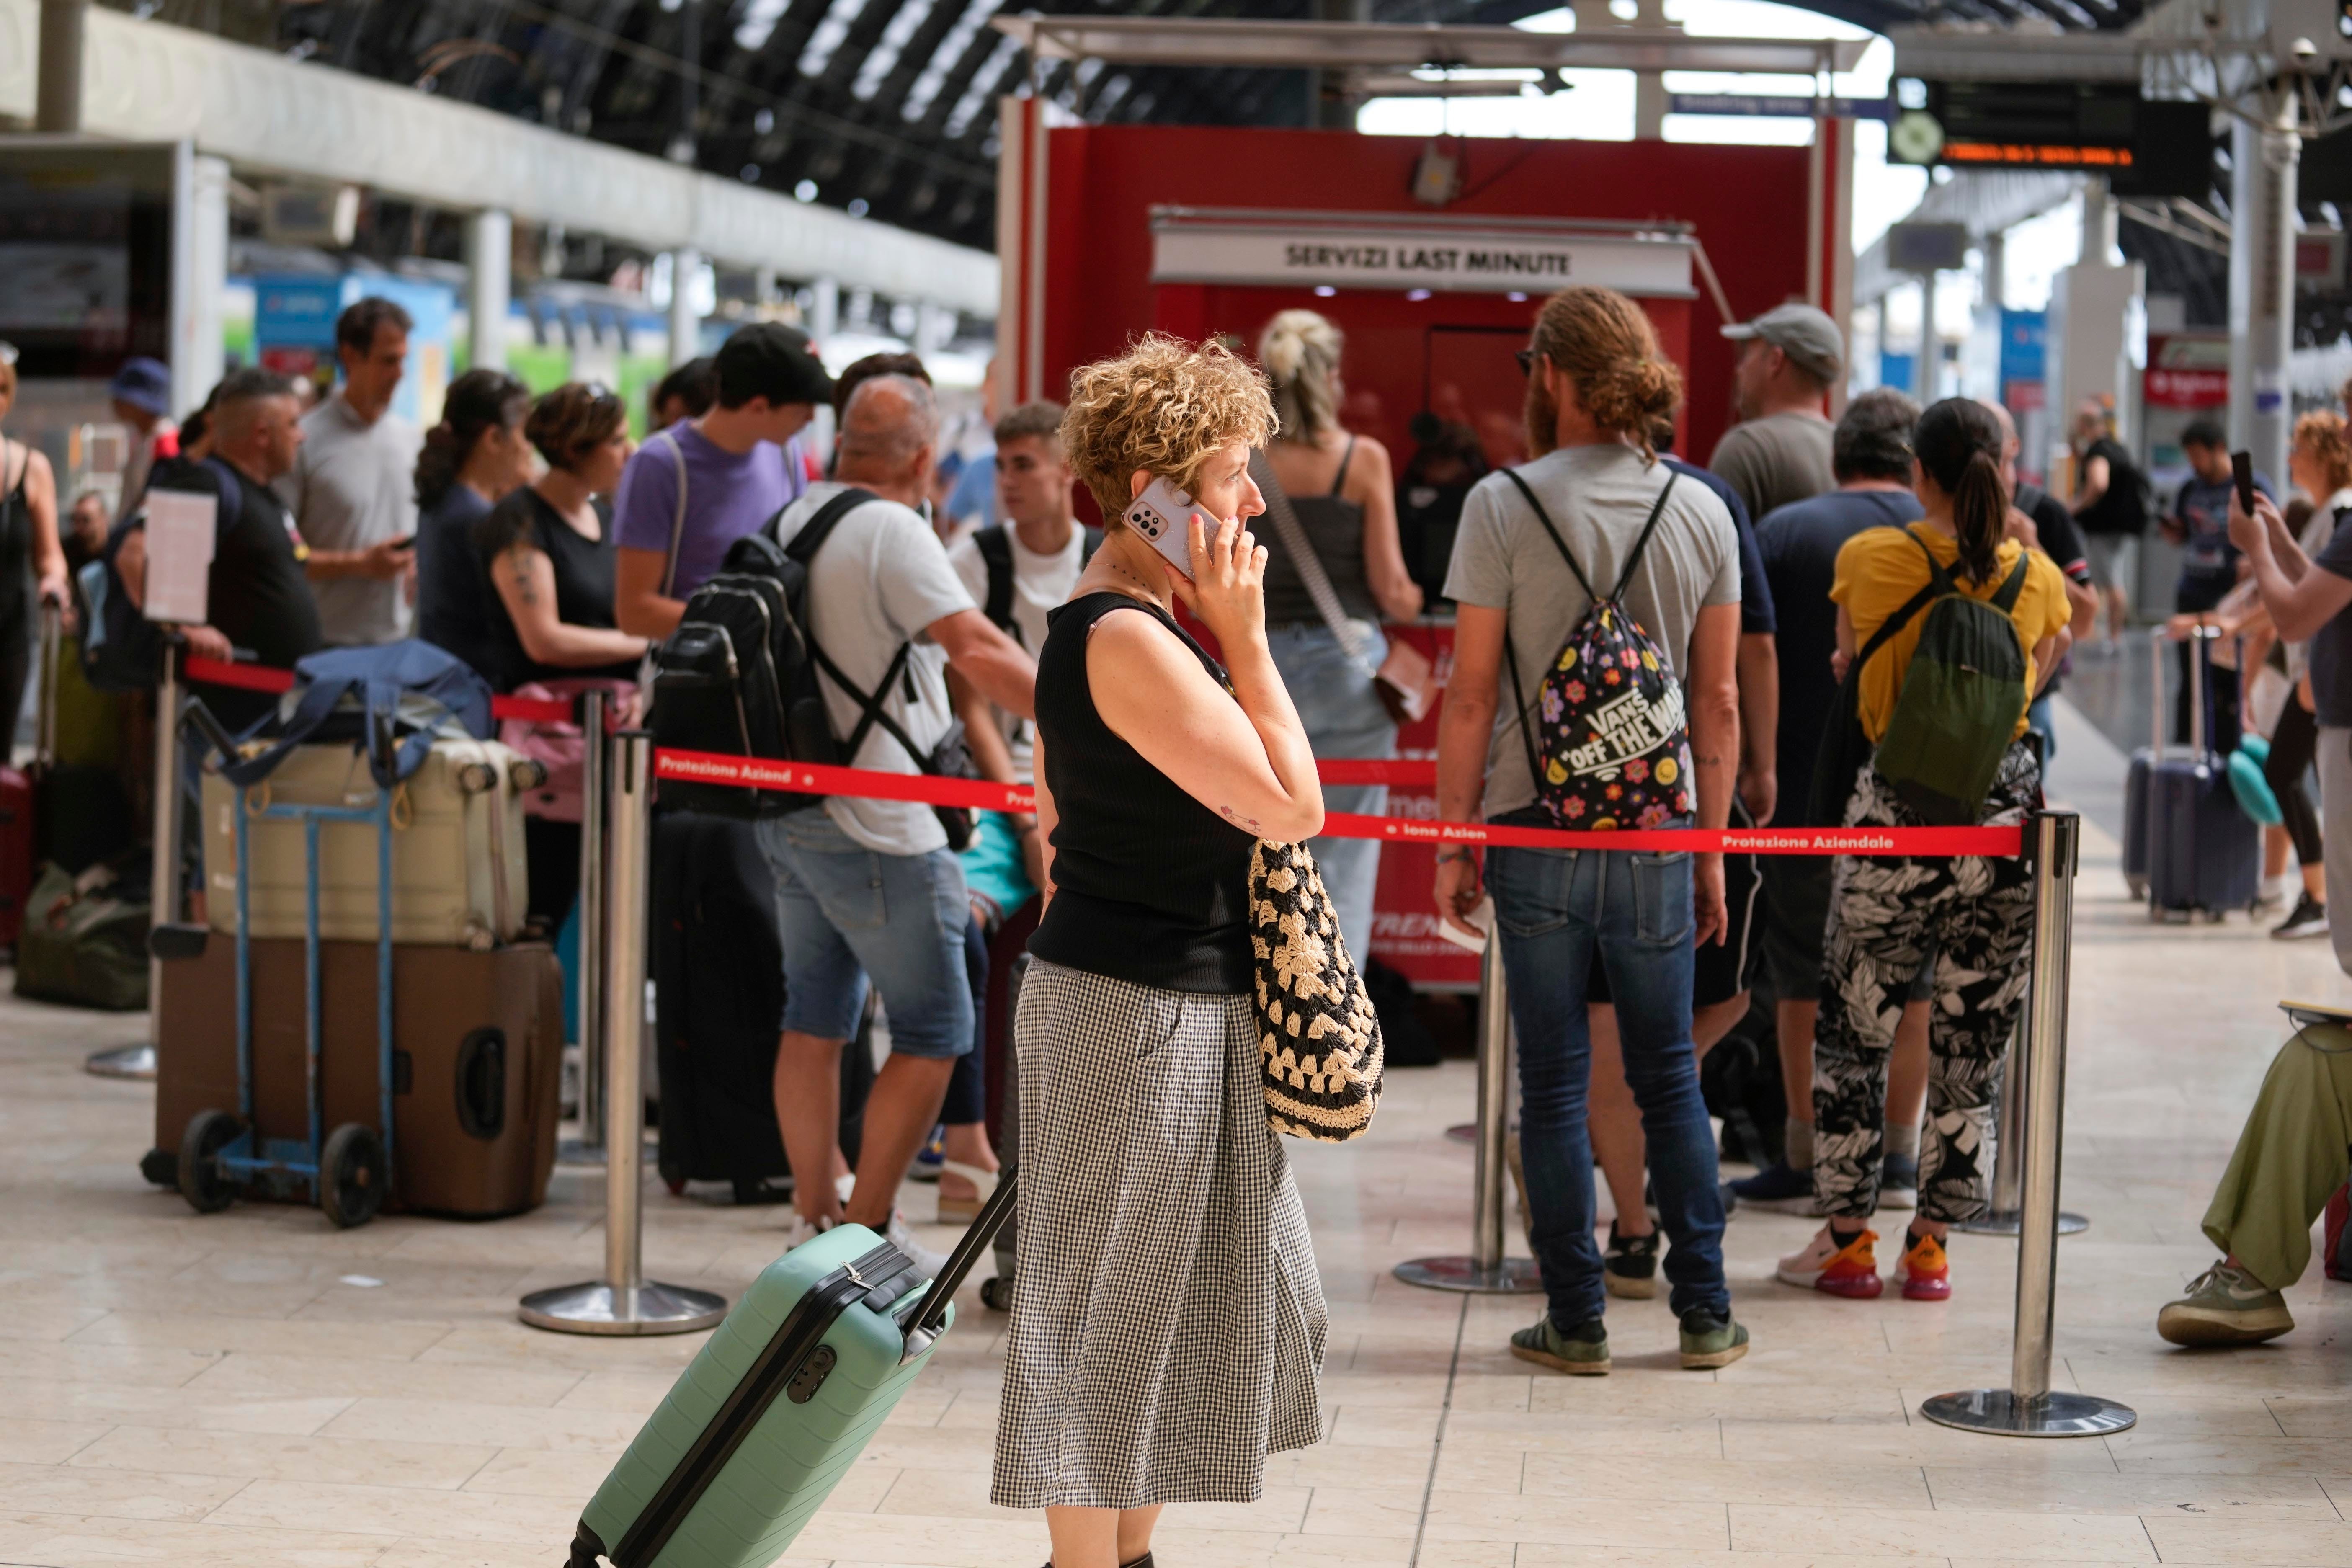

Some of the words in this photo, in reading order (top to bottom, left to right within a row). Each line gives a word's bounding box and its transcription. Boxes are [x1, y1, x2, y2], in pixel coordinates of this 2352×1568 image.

[1285, 244, 1388, 268] SERVIZI
[1397, 248, 1458, 271] LAST
[1467, 250, 1571, 275] MINUTE
[1585, 687, 1649, 735] VANS
[1604, 715, 1658, 757] THE
[660, 756, 738, 778] Protezione
[1722, 836, 1809, 848] Protezione
[1813, 835, 1894, 848] Aziendale
